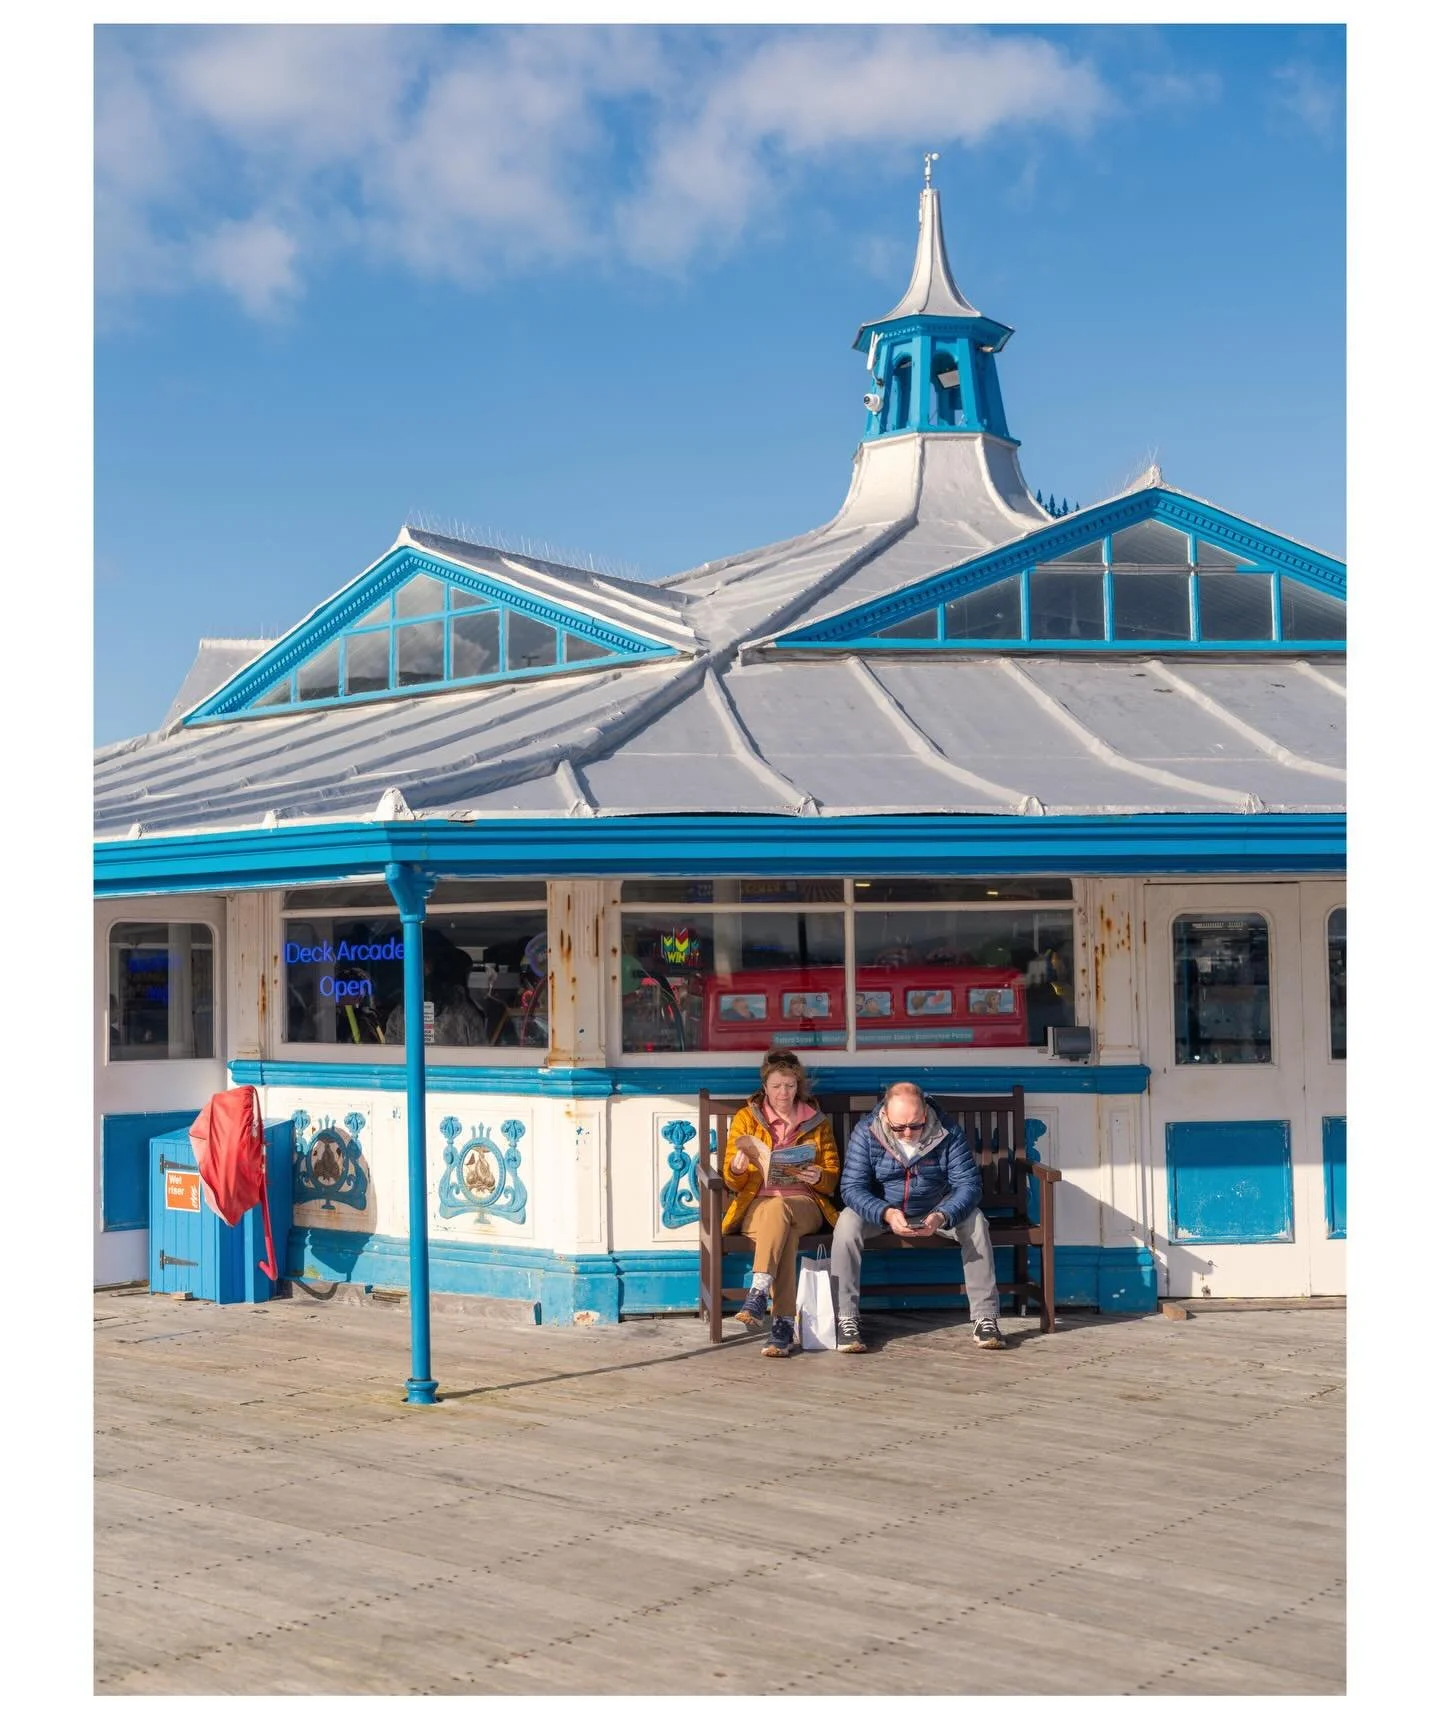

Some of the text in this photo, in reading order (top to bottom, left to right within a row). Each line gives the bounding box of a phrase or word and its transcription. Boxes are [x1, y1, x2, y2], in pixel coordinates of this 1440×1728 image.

[284, 937, 404, 963] Deck Arcade
[667, 951, 686, 963] WIN
[319, 975, 373, 1003] Open
[168, 1174, 182, 1185] Wet
[168, 1186, 185, 1196] riser
